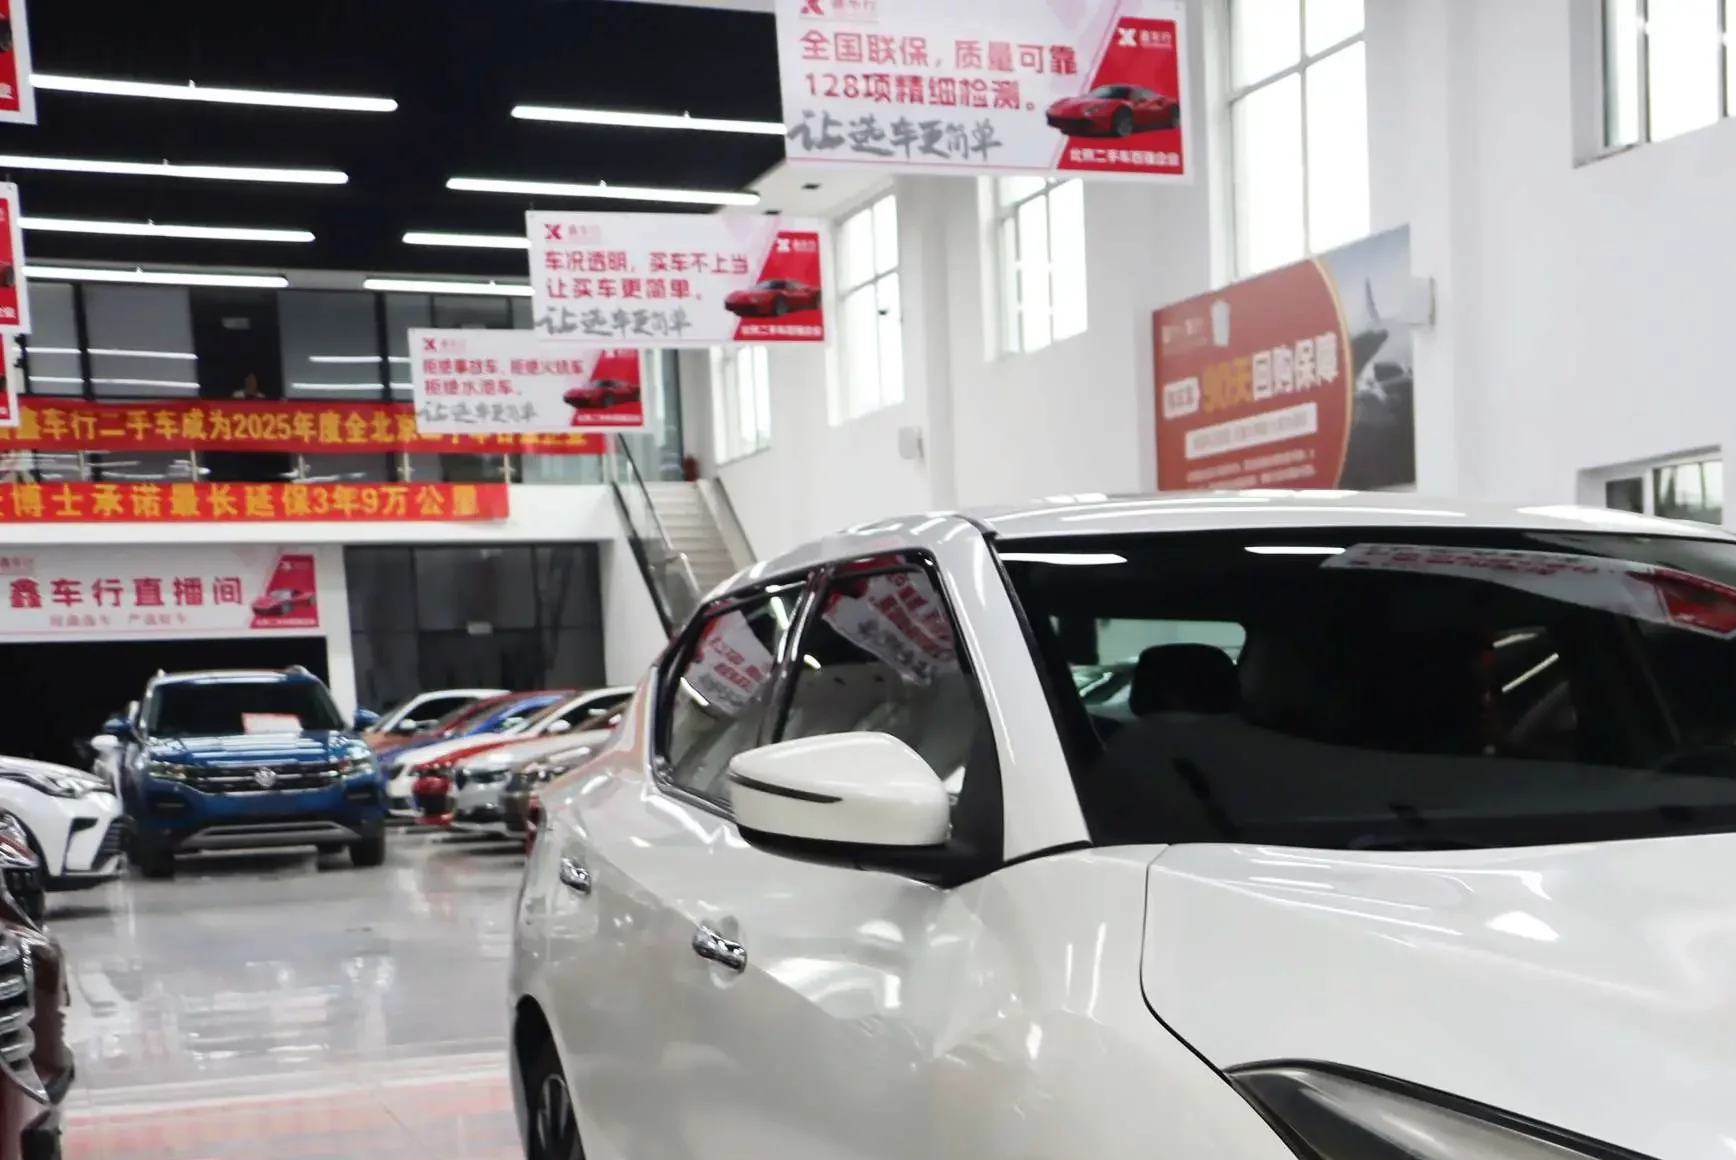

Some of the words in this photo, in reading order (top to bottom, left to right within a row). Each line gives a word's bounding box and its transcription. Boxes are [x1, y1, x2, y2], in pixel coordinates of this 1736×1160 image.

[800, 29, 1077, 76] 全国联保，质量可靠
[805, 72, 1036, 112] 128项精细检测。
[787, 109, 1004, 161] 让选车更简单
[545, 250, 749, 275] 车况透明，买车不上当
[0, 482, 480, 519] 博士承诺最长延保3年9万公里
[9, 577, 244, 609] 鑫车行直播间
